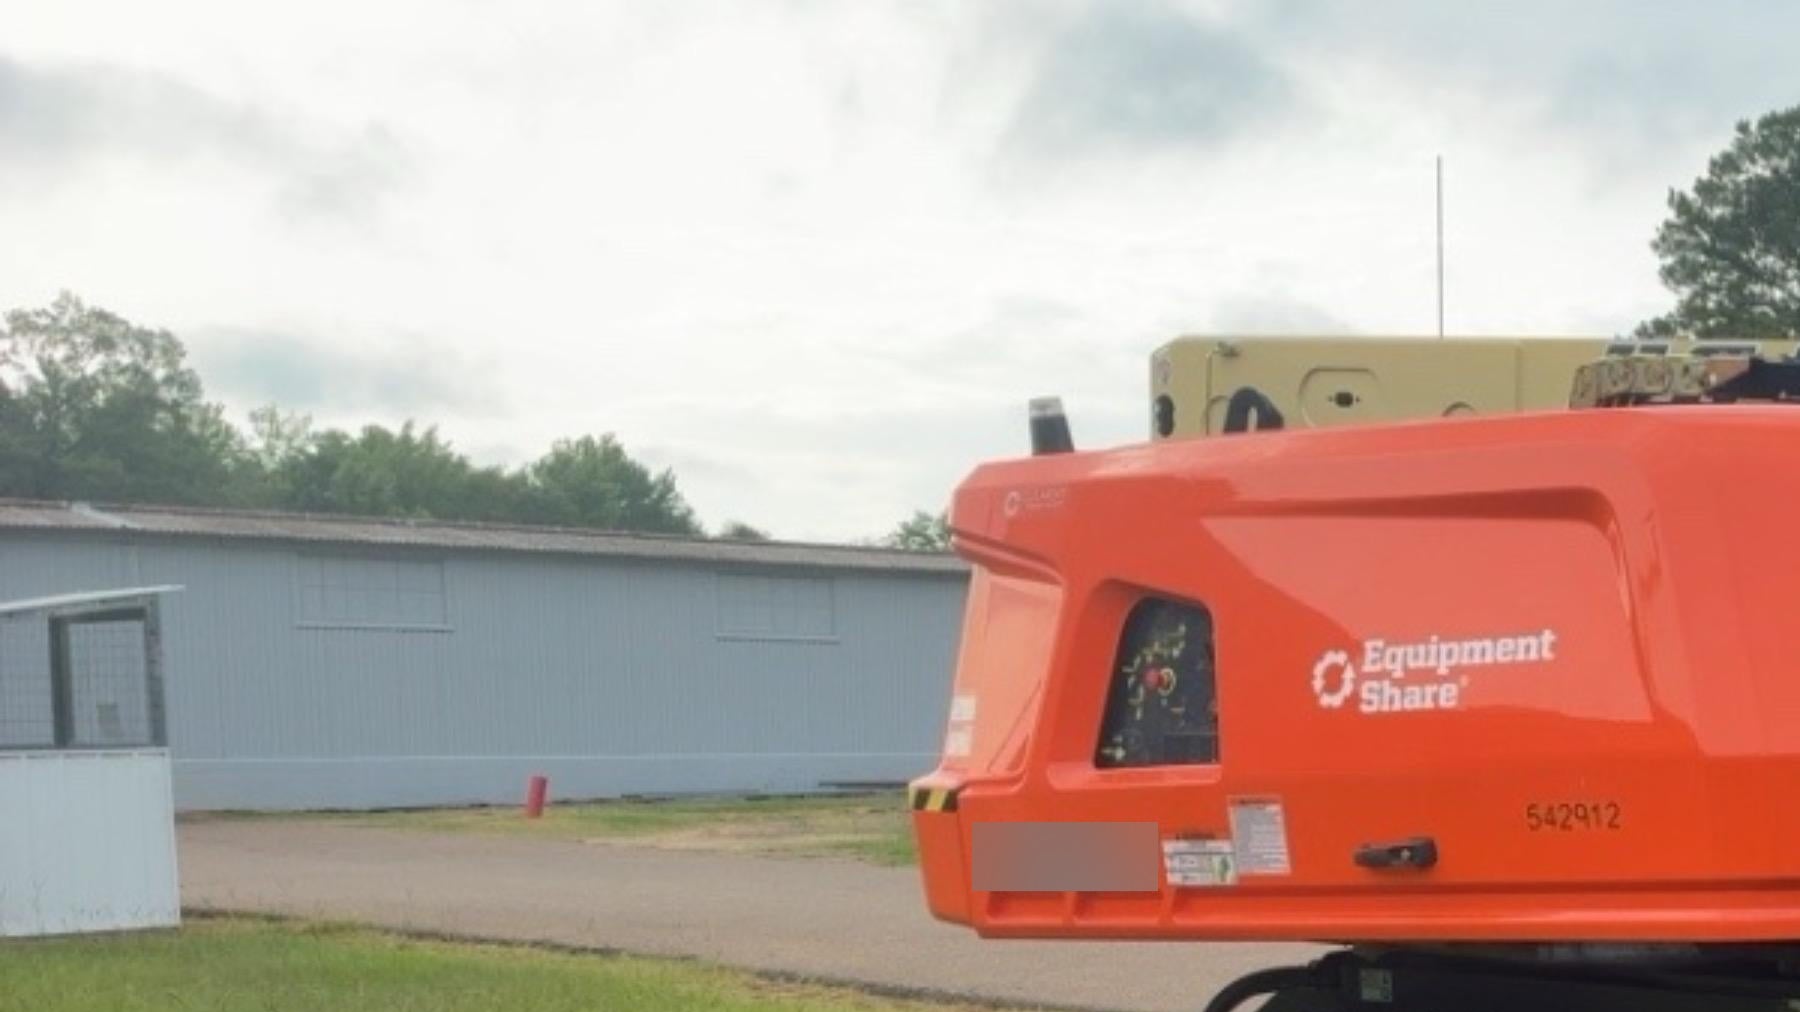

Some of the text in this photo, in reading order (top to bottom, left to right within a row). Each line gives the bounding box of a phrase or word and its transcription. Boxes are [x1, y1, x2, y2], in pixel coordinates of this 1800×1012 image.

[1361, 627, 1557, 678] Equipment
[1359, 678, 1459, 714] Share
[1525, 801, 1622, 832] 542912
